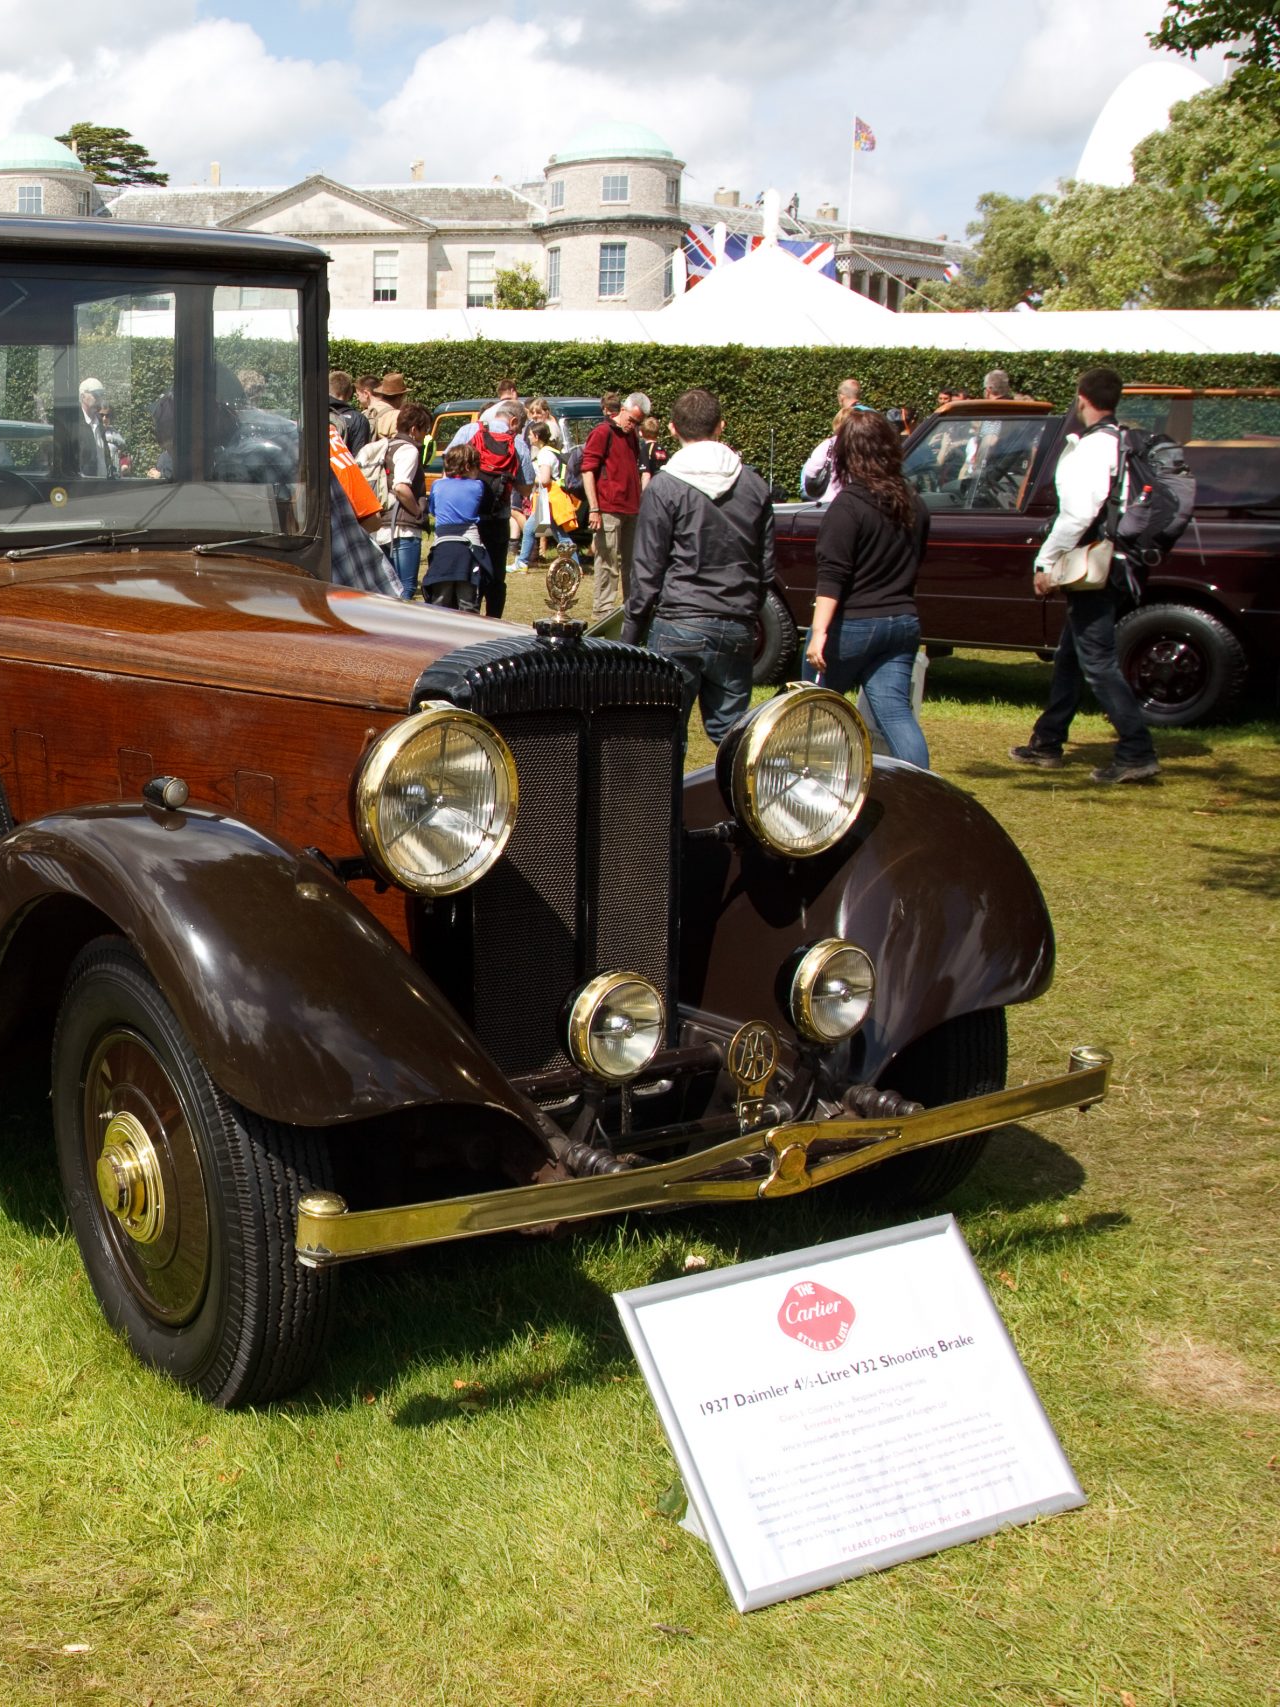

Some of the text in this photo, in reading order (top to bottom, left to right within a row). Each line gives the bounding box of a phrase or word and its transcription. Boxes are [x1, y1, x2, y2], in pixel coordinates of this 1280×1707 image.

[794, 1283, 816, 1298] THE
[785, 1298, 842, 1325] Cartier
[796, 1321, 849, 1351] STYLE ET LUXE
[699, 1397, 730, 1416] 1937
[734, 1385, 790, 1407] Daimler
[850, 1358, 879, 1375] V32
[880, 1346, 938, 1368] Shooting
[938, 1335, 975, 1353] Brake
[842, 1508, 971, 1553] PLEASE DO NOT TOUCH THE CAR
